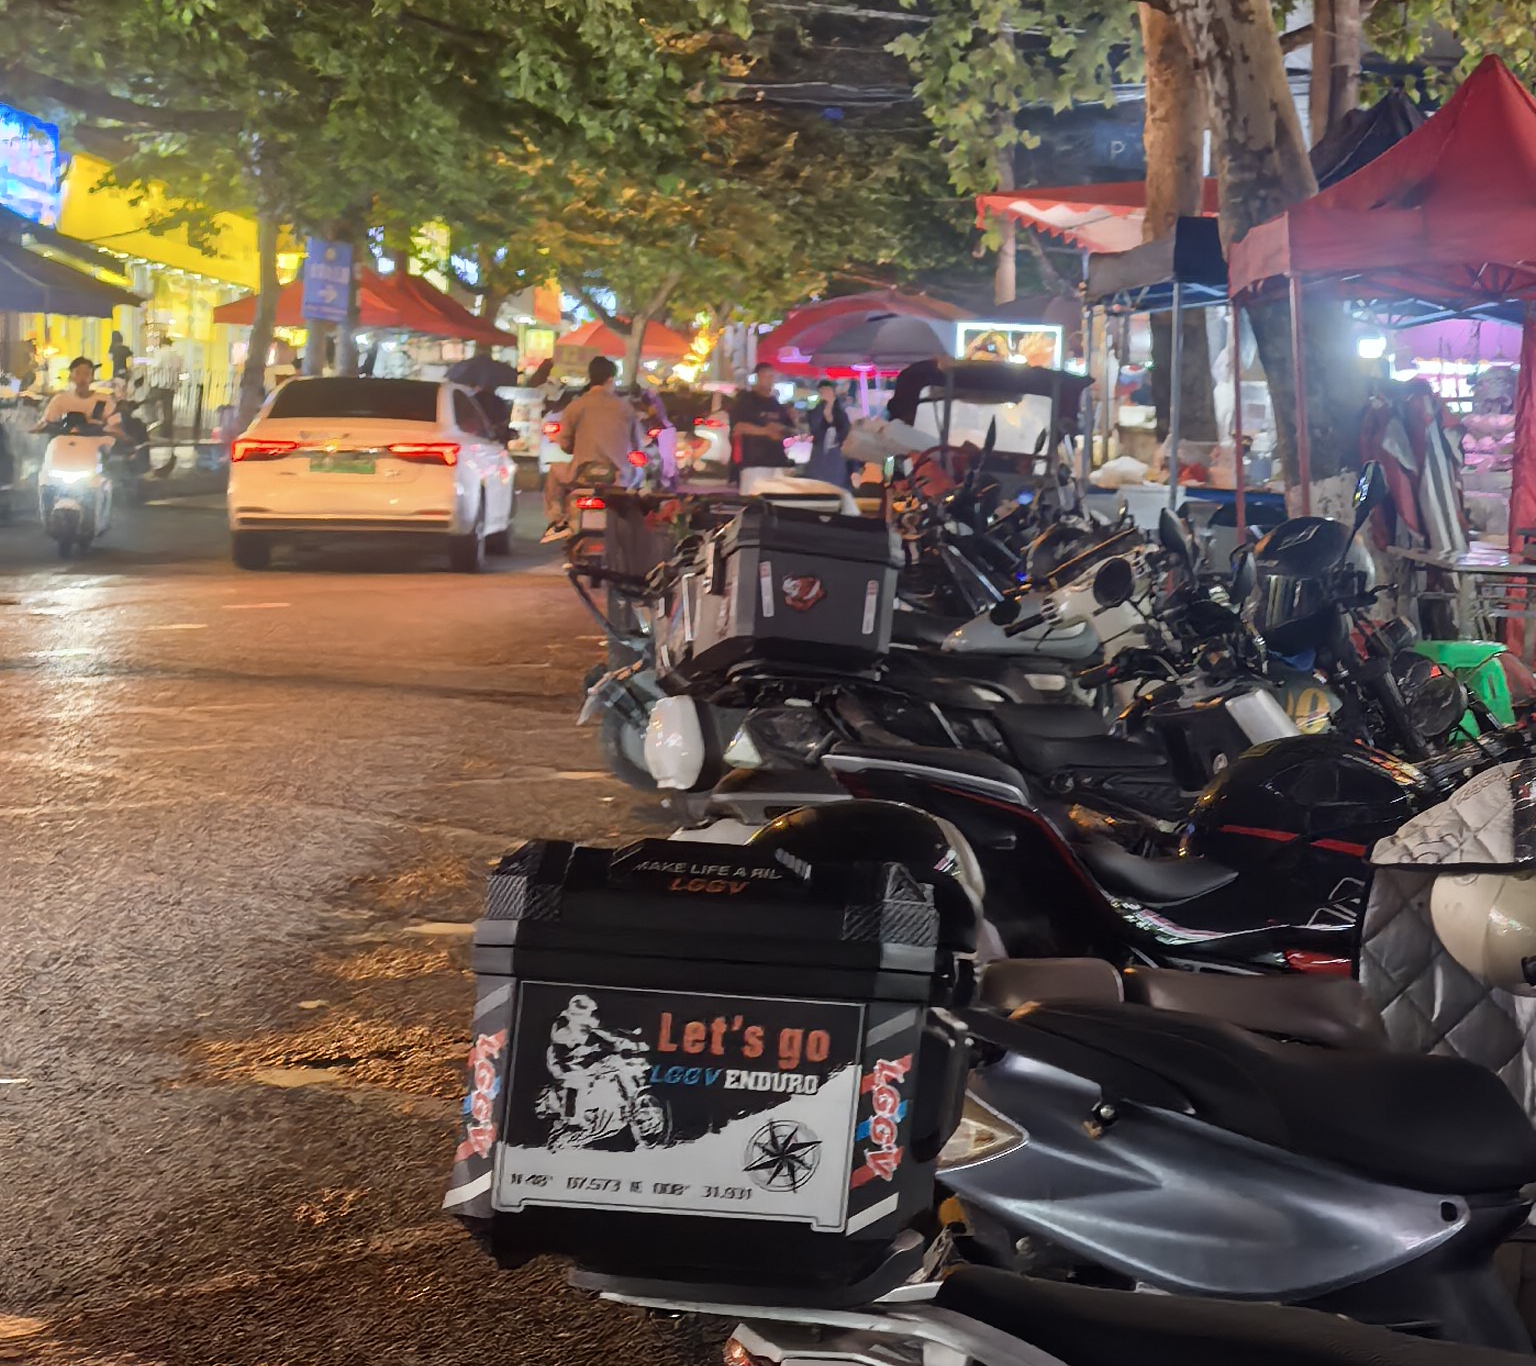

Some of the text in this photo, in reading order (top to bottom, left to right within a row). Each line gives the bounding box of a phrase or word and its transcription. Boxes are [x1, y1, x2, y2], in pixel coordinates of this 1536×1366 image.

[690, 864, 731, 876] LIFE
[657, 1012, 831, 1070] Let's go
[724, 1068, 820, 1095] ENDURO
